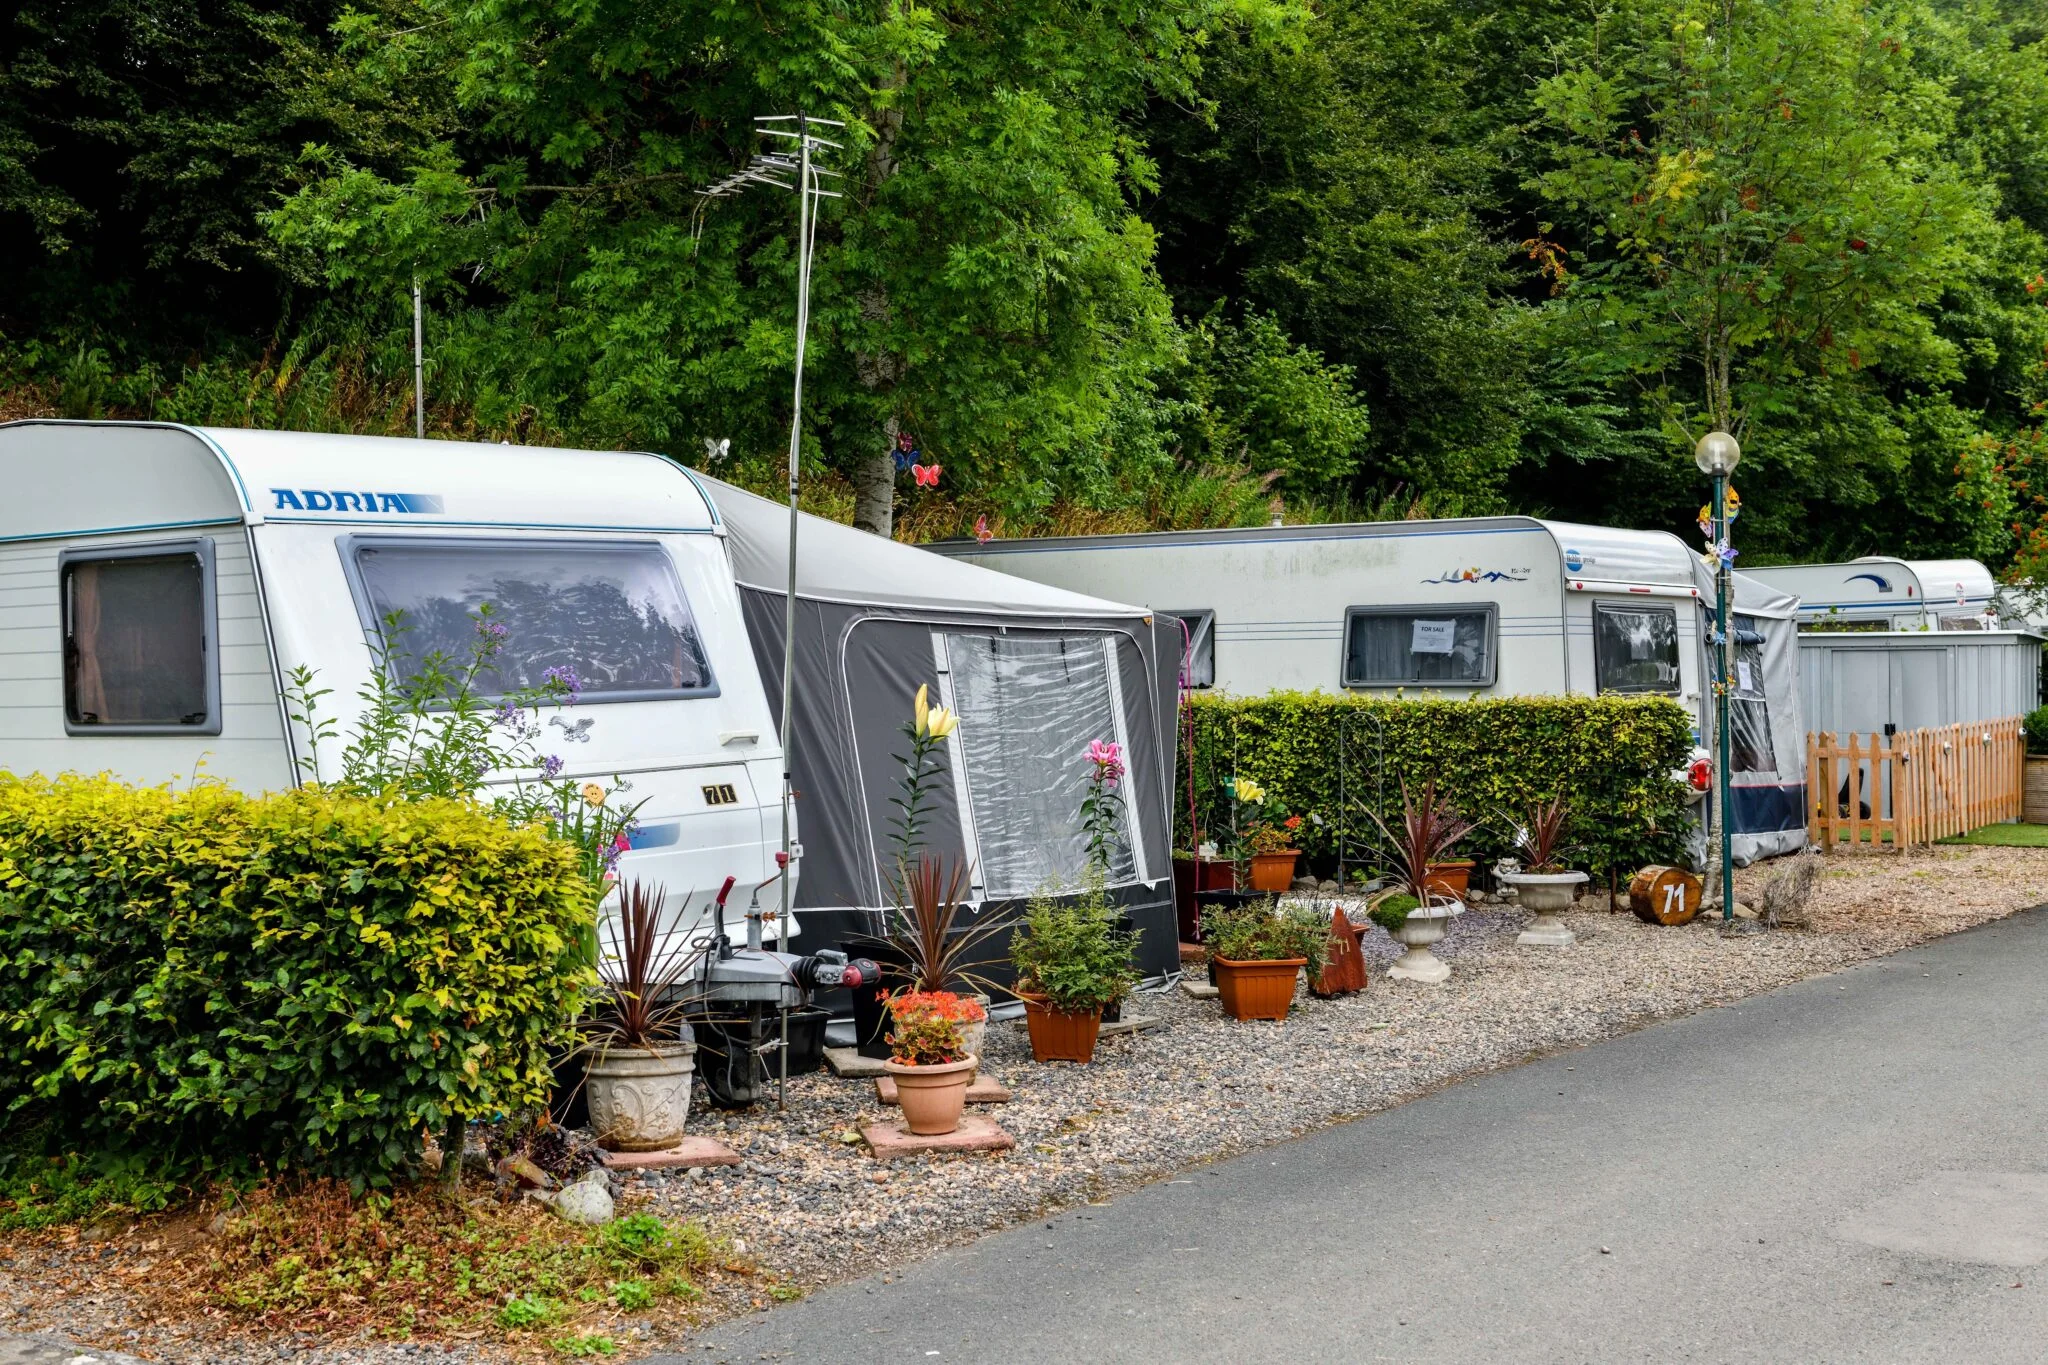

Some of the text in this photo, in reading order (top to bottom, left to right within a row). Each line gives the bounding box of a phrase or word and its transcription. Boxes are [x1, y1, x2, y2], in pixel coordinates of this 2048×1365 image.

[271, 488, 408, 513] ADRIA
[704, 786, 735, 804] 71
[1662, 883, 1685, 914] 71
